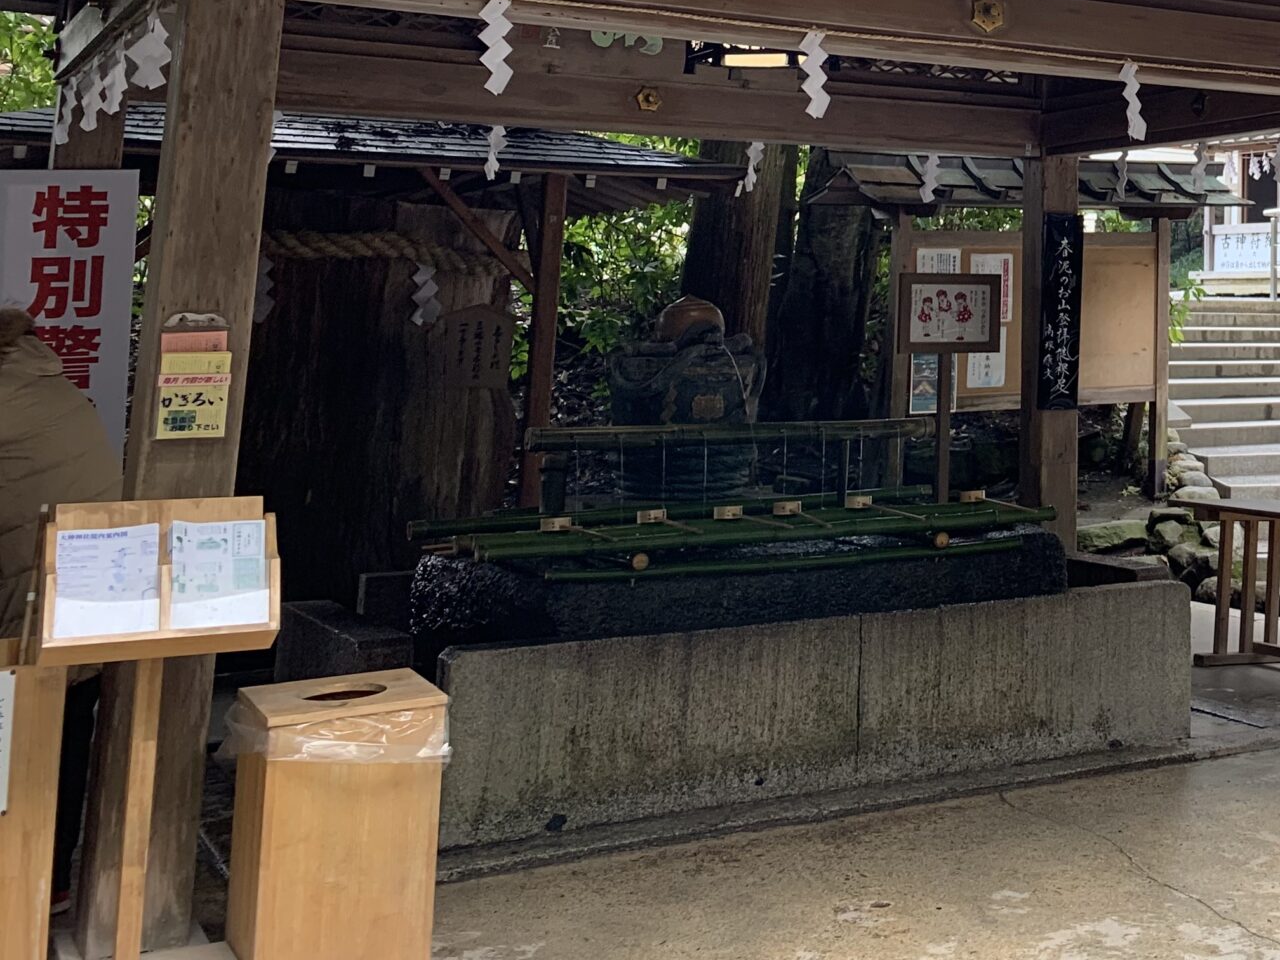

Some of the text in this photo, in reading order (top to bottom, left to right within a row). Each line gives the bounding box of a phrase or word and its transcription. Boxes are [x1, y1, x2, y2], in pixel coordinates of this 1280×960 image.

[26, 185, 109, 408] 特別警
[161, 392, 224, 408] かぎろい
[168, 422, 219, 432] お取り下さい
